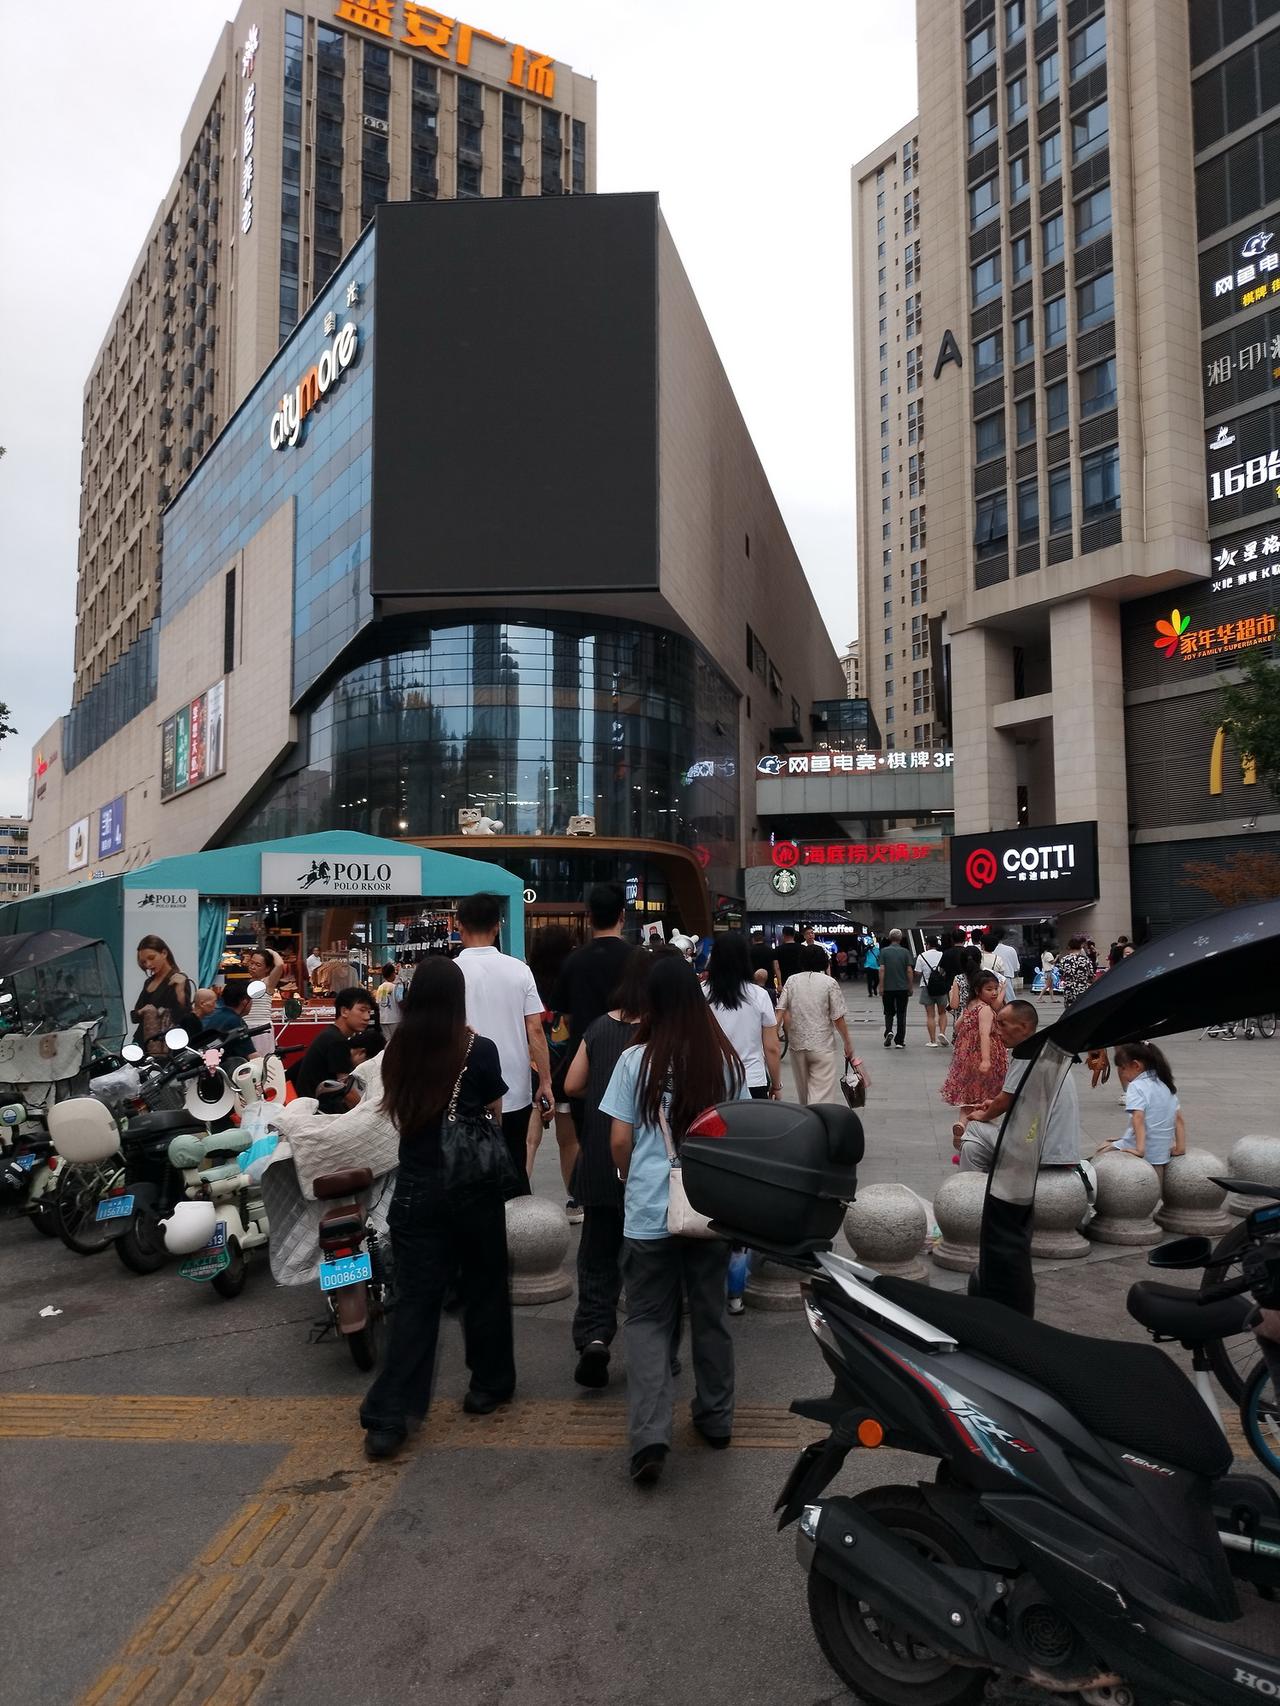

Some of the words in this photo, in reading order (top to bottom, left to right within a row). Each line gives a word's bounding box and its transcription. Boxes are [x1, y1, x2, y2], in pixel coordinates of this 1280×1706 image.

[334, 0, 556, 99] 盛安广场
[933, 329, 963, 380] A
[270, 321, 358, 451] citymore
[1179, 613, 1276, 655] 家年华超市
[1183, 653, 1197, 662] JOY
[1198, 647, 1223, 658] FAMILY
[1002, 844, 1076, 872] COTTI
[333, 862, 392, 882] POLO
[155, 894, 187, 904] POLO
[333, 882, 359, 891] POLO
[361, 882, 392, 892] RKOSR
[828, 923, 854, 935] coffee
[324, 1266, 369, 1287] 0008638
[1232, 1667, 1280, 1700] HO
